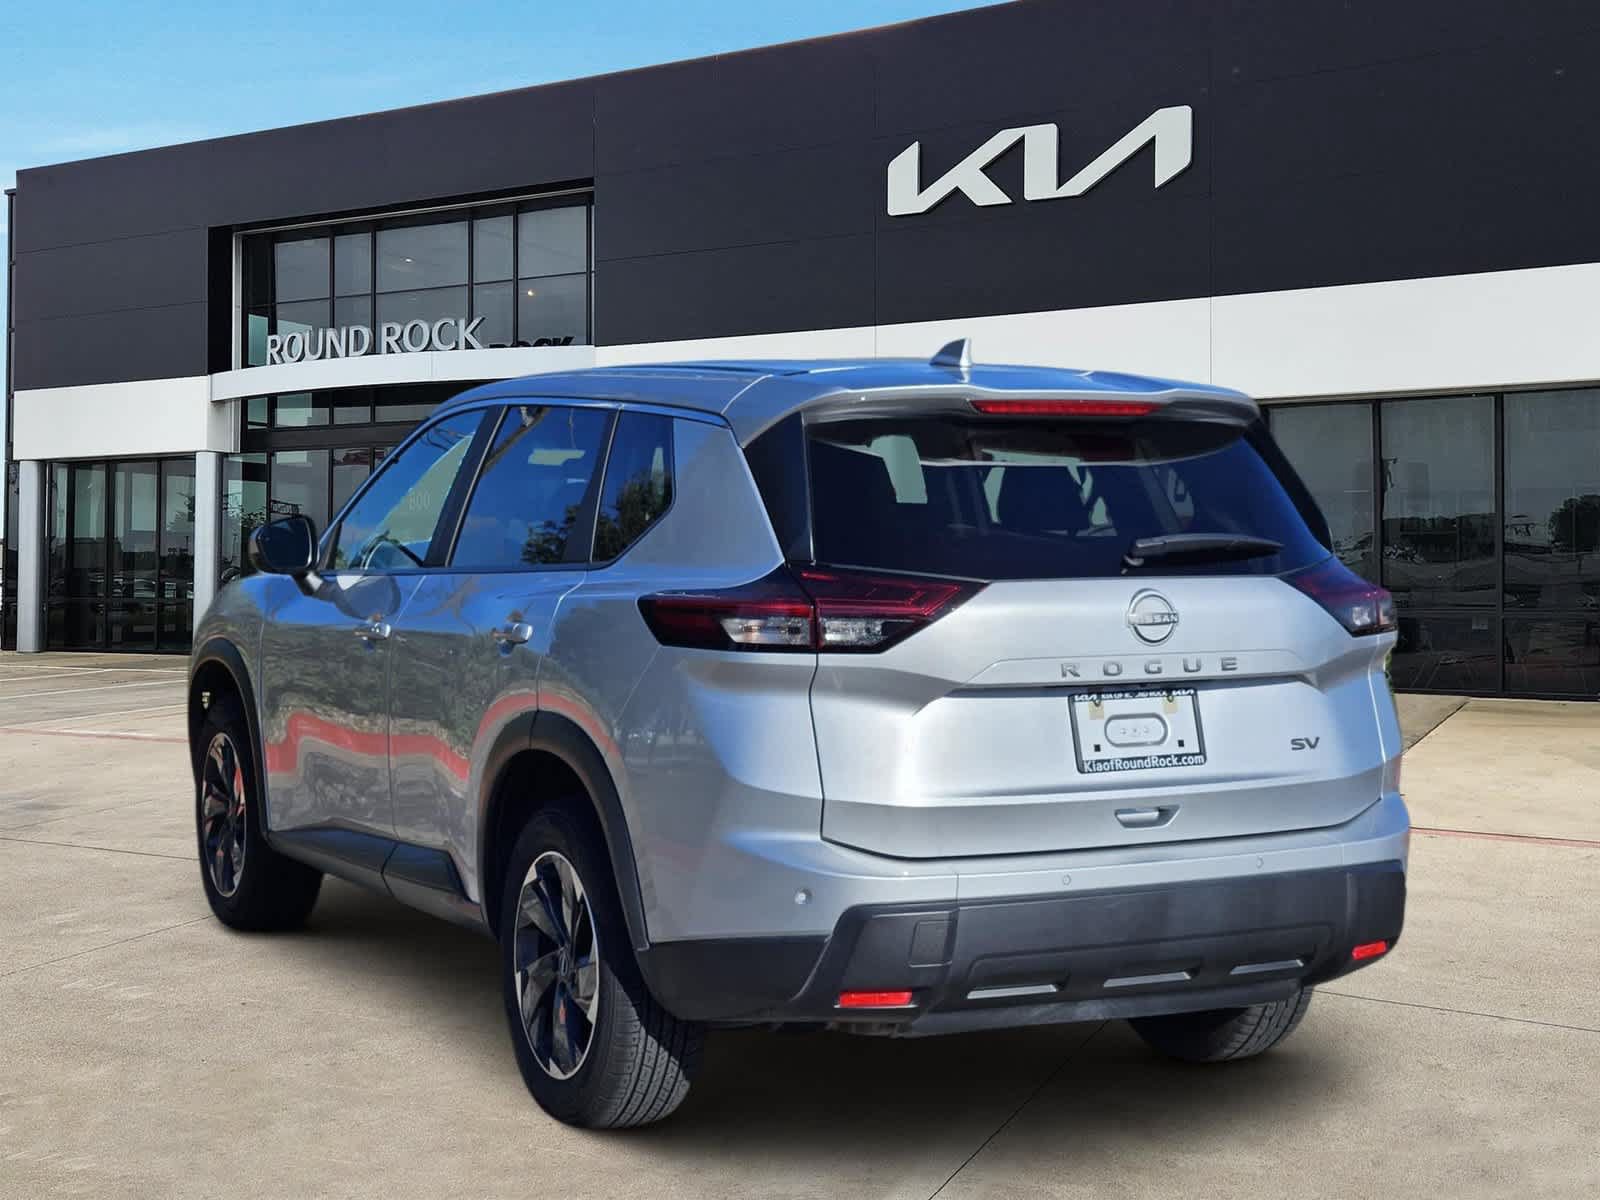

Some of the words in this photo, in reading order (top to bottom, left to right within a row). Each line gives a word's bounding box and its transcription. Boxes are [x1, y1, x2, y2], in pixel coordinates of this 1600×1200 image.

[888, 104, 1193, 217] KIA
[266, 325, 371, 365] ROUND
[381, 317, 485, 354] ROCK
[1061, 656, 1239, 678] ROGUE
[1290, 736, 1320, 751] SV
[1083, 755, 1205, 773] KiaofRoundRock.com
